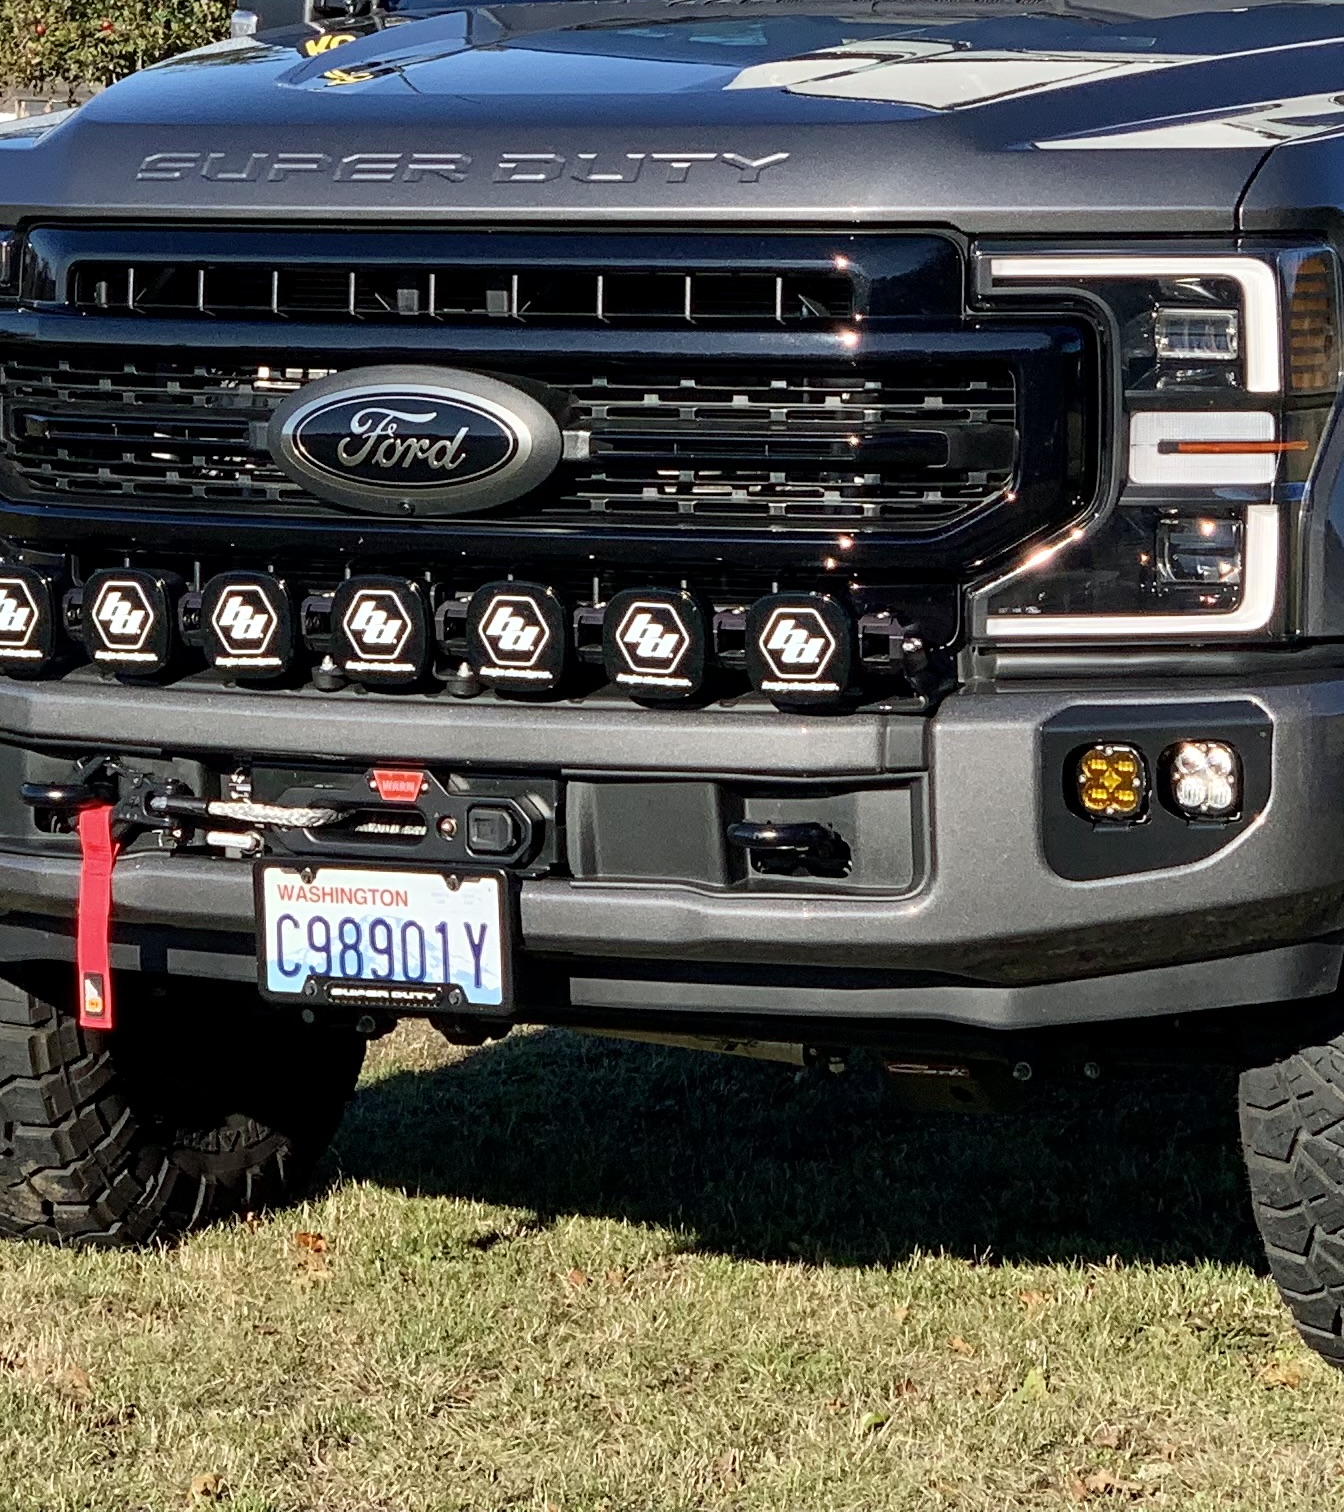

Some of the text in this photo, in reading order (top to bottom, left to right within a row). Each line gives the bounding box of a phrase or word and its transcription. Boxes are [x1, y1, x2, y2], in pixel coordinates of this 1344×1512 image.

[136, 152, 790, 183] SUPER DUTY
[337, 407, 470, 470] Ford
[277, 883, 409, 908] WASHINGTON
[276, 913, 488, 989] C98901Y
